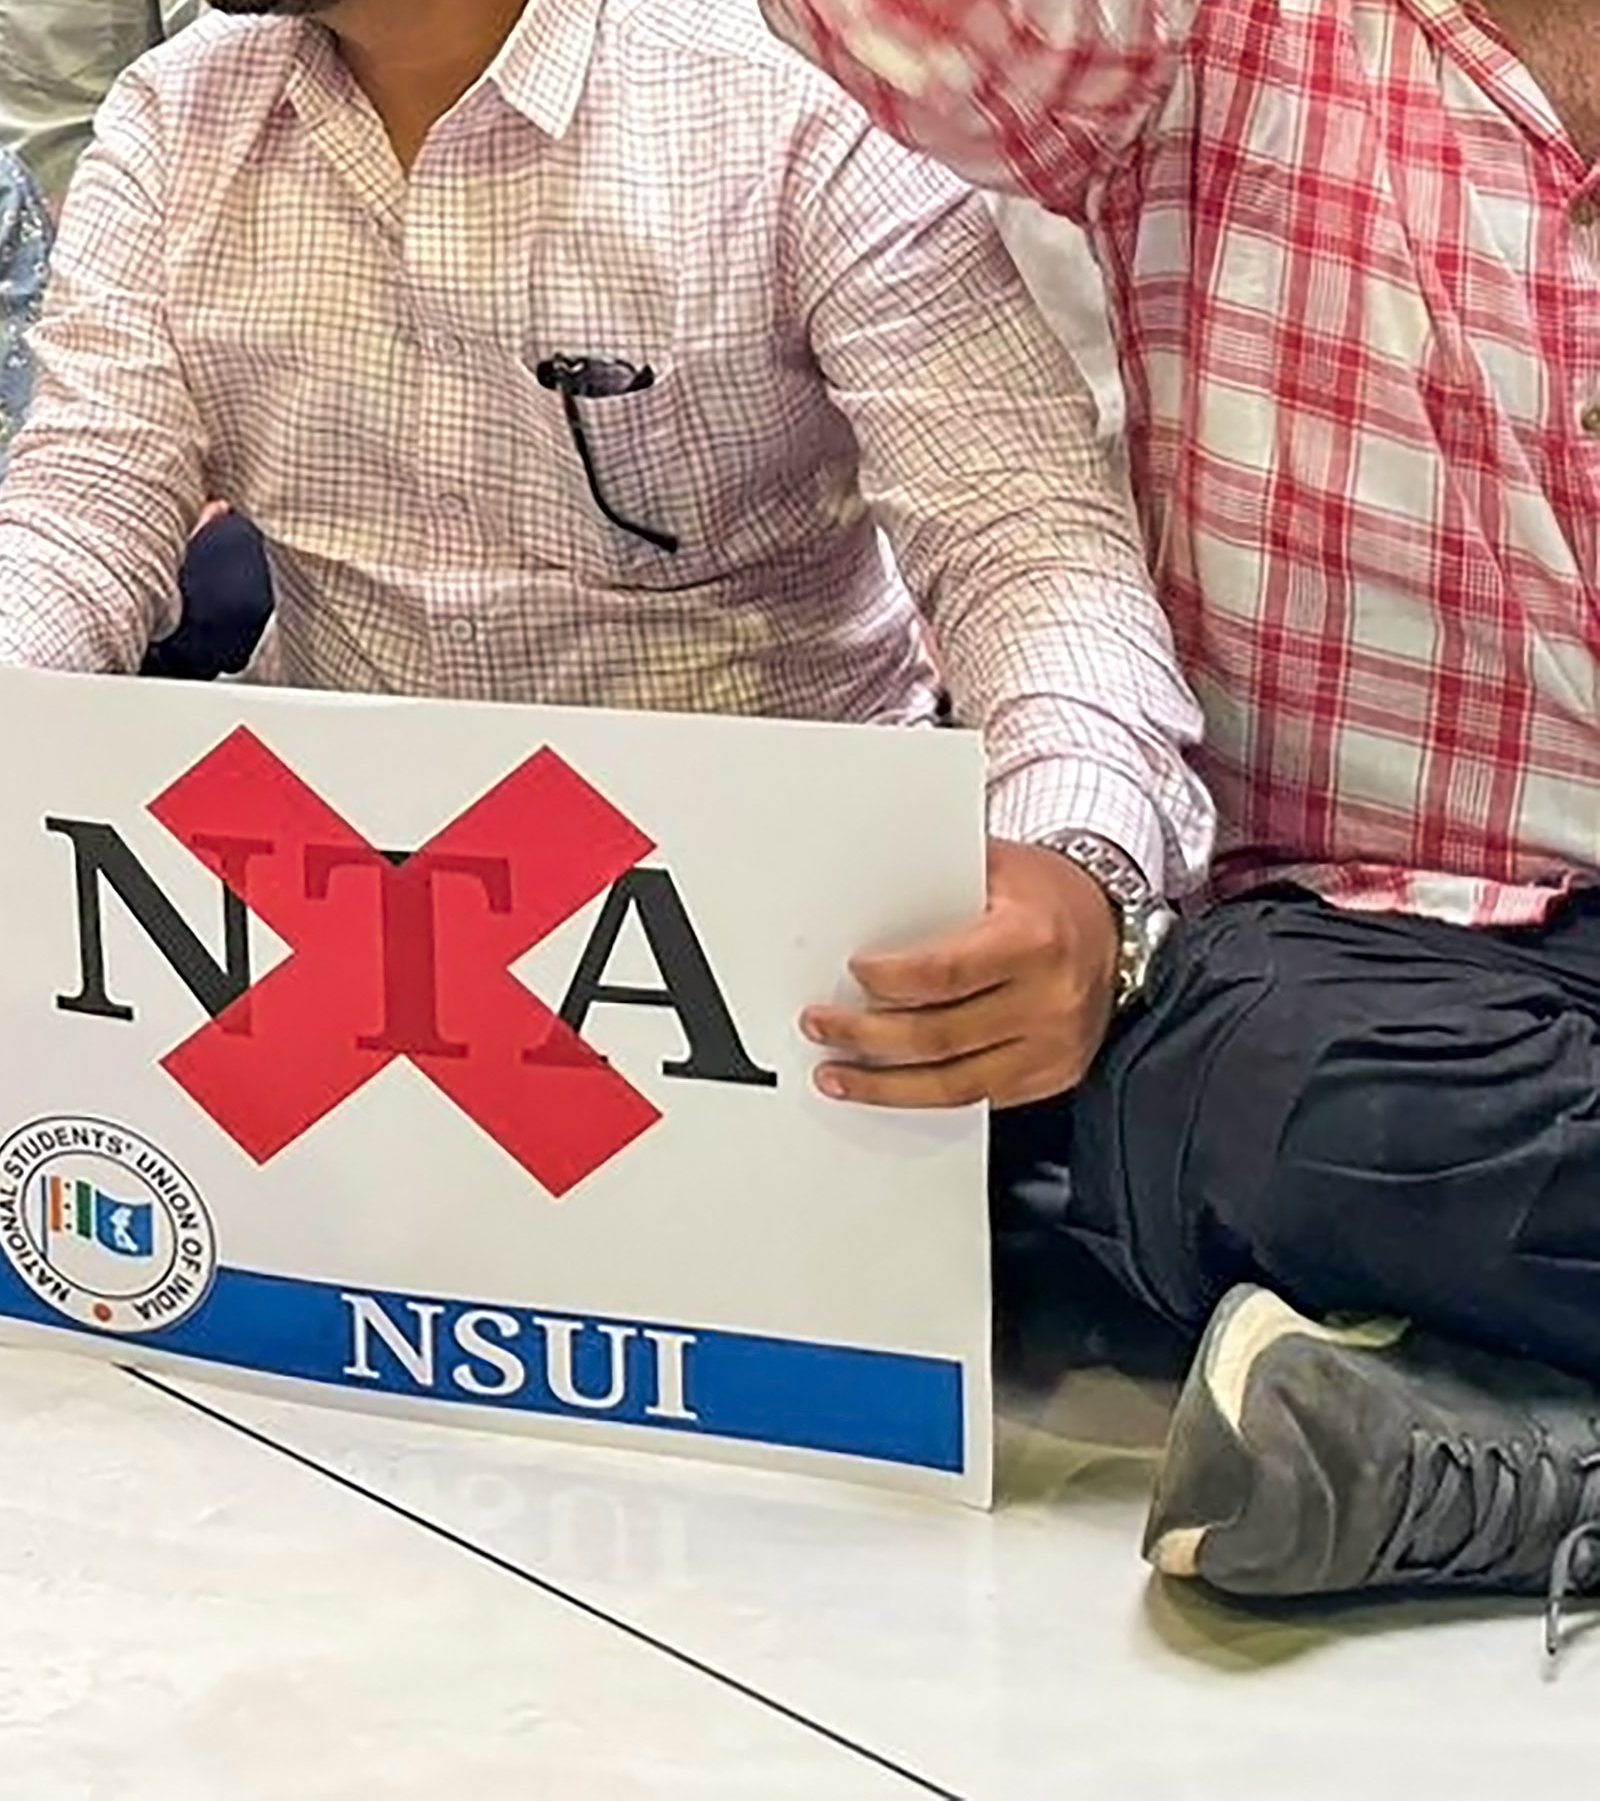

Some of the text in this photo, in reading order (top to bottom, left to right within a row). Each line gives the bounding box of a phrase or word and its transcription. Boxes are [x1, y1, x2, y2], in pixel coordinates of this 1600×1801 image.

[44, 815, 778, 1089] NTA
[3, 1126, 132, 1179] STUDENTS'
[136, 1152, 199, 1231] UNION
[181, 1238, 203, 1273] OF
[133, 1273, 193, 1320] INDIA
[343, 1293, 698, 1422] NSUI
